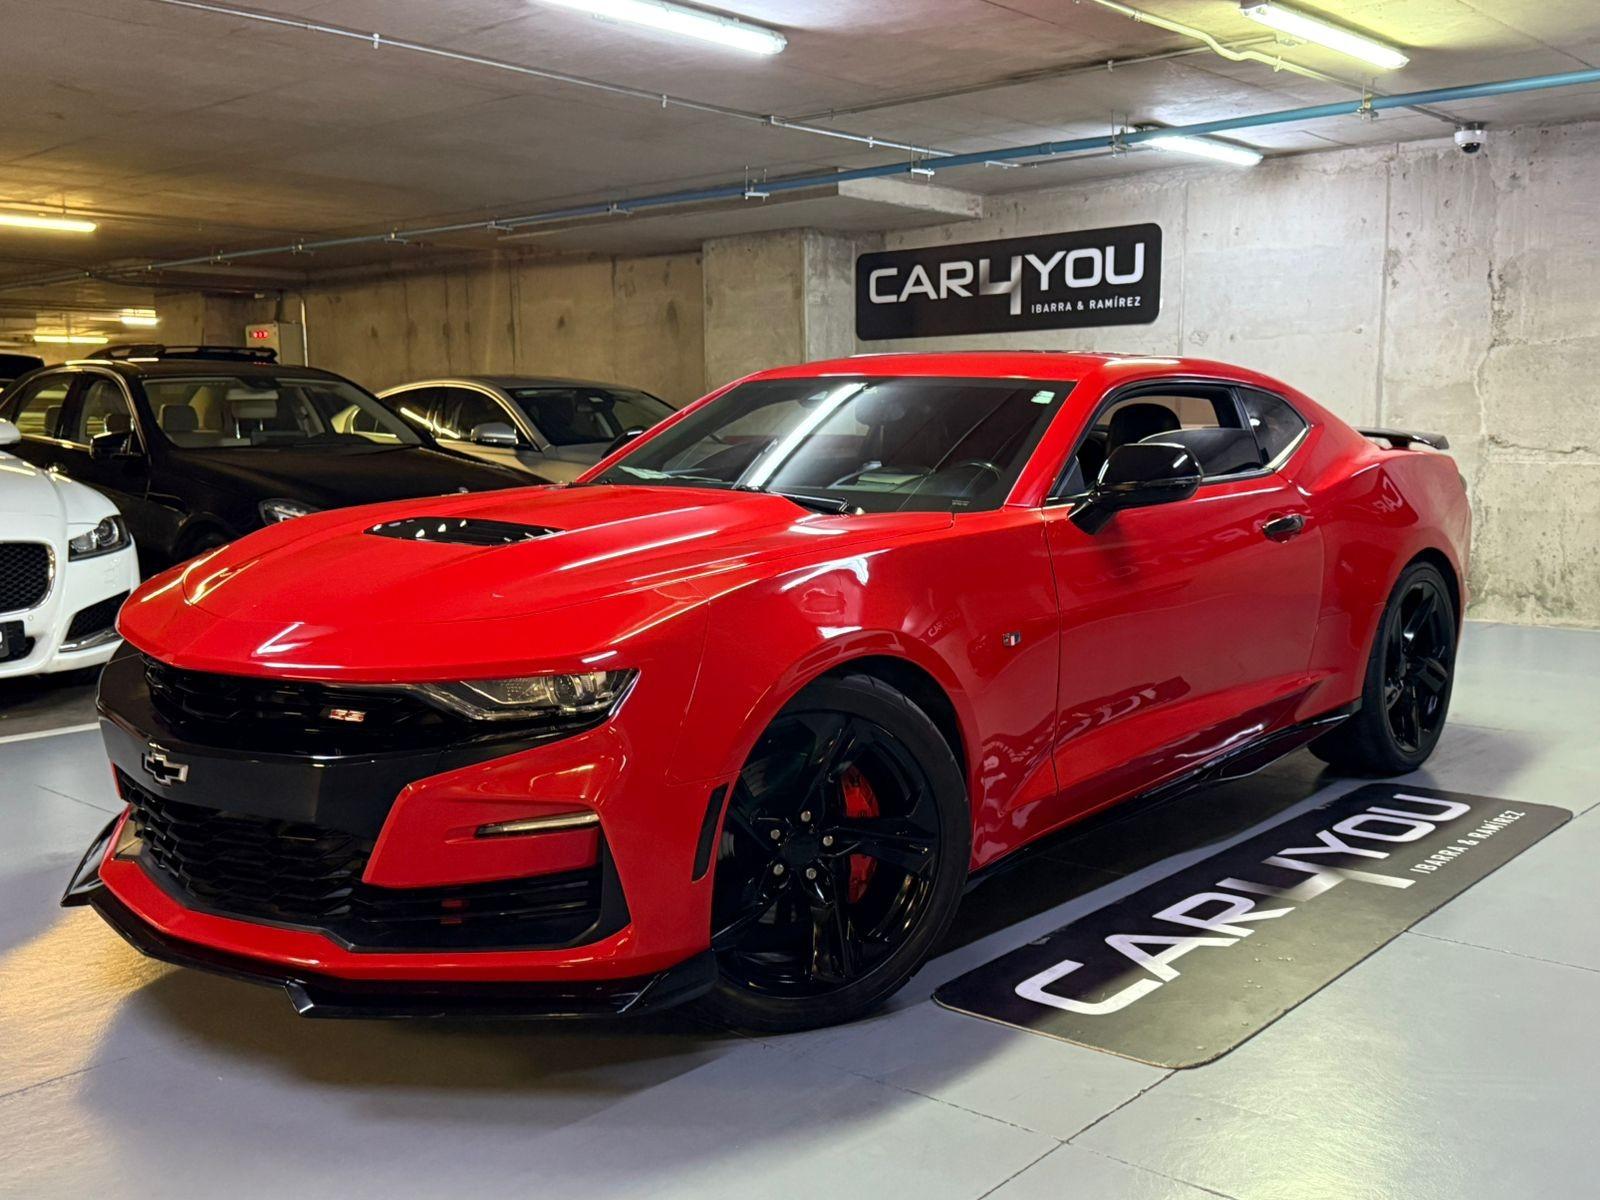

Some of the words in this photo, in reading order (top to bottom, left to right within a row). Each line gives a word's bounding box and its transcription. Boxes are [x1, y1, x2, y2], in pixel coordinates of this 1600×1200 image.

[869, 242, 1145, 316] CAR4YOU
[1031, 301, 1073, 314] IBARRA
[1077, 300, 1085, 311] &
[1089, 295, 1142, 310] RAMÍREZ
[1409, 845, 1470, 874] IBARRA
[1467, 809, 1526, 839] RAMÍREZ
[1014, 793, 1472, 1015] CAR4YOU
